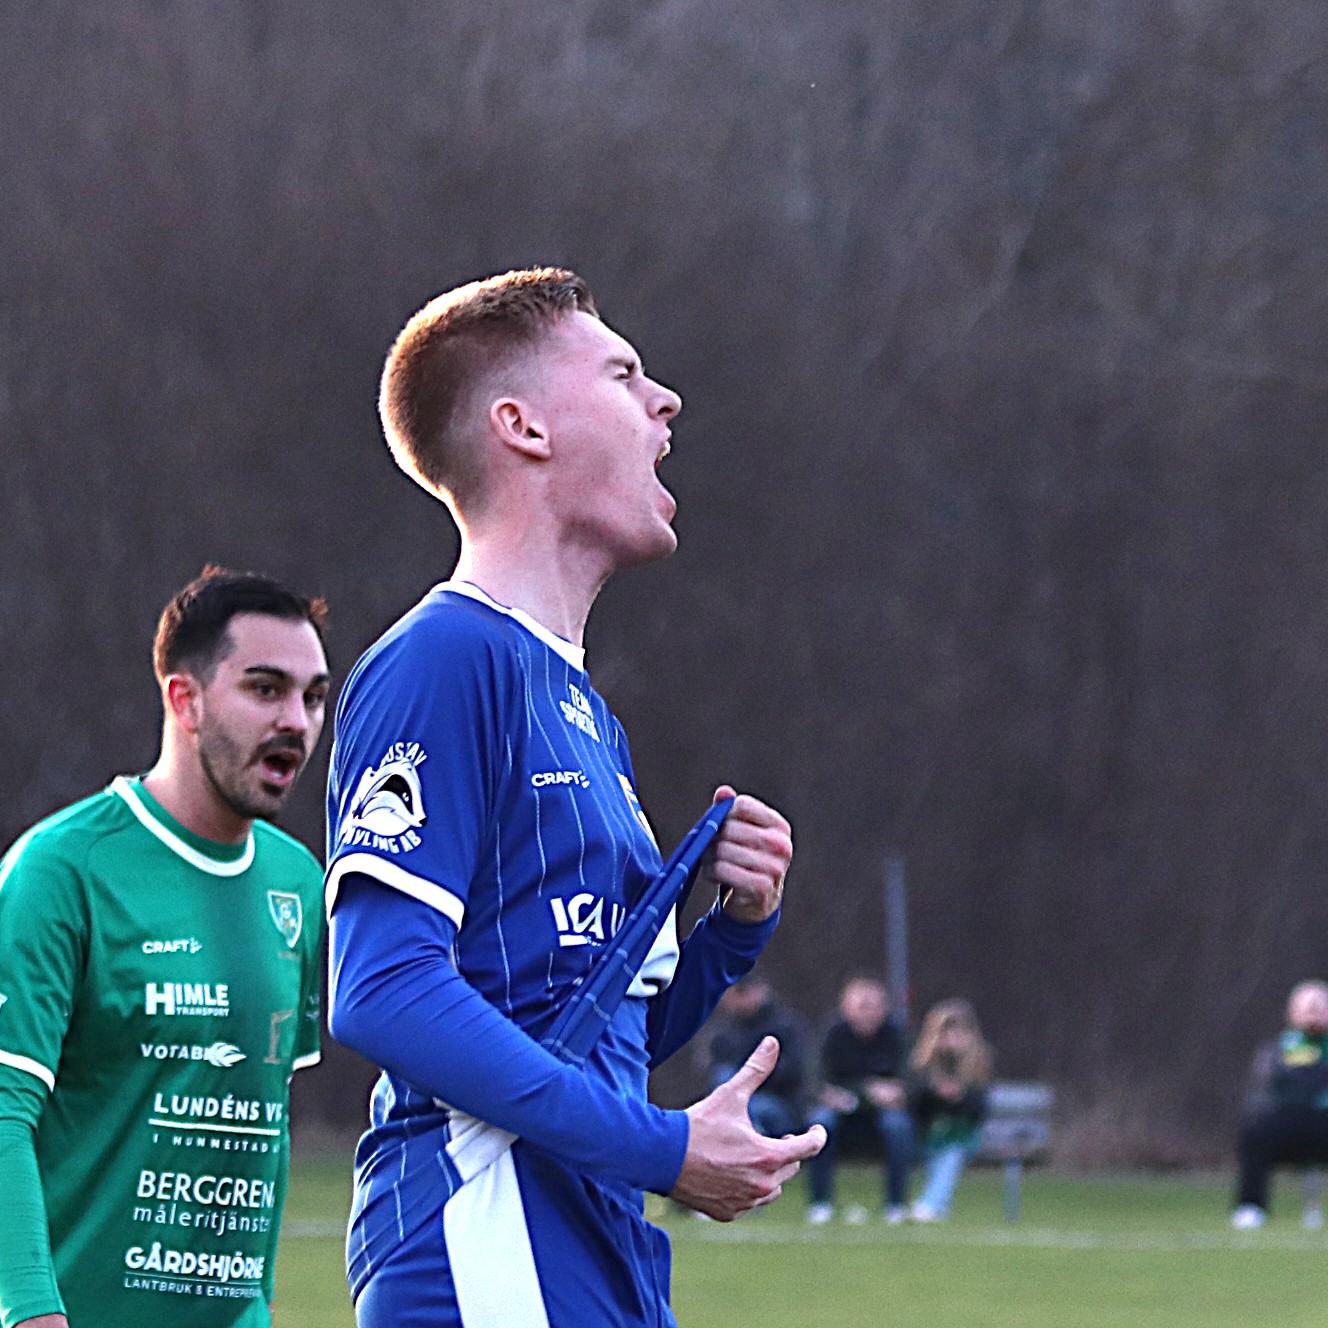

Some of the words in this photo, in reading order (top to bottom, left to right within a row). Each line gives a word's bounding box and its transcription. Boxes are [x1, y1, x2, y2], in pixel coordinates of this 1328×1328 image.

[531, 771, 580, 787] CRAFT
[550, 892, 605, 941] ICA
[141, 939, 190, 954] CRAFT
[145, 981, 230, 1016] HIMLE
[175, 1006, 230, 1018] TRANSPORT
[153, 1092, 260, 1121] LUNDÉNS
[136, 1169, 276, 1209] BERGGREN
[124, 1277, 192, 1294] LANTBRUK
